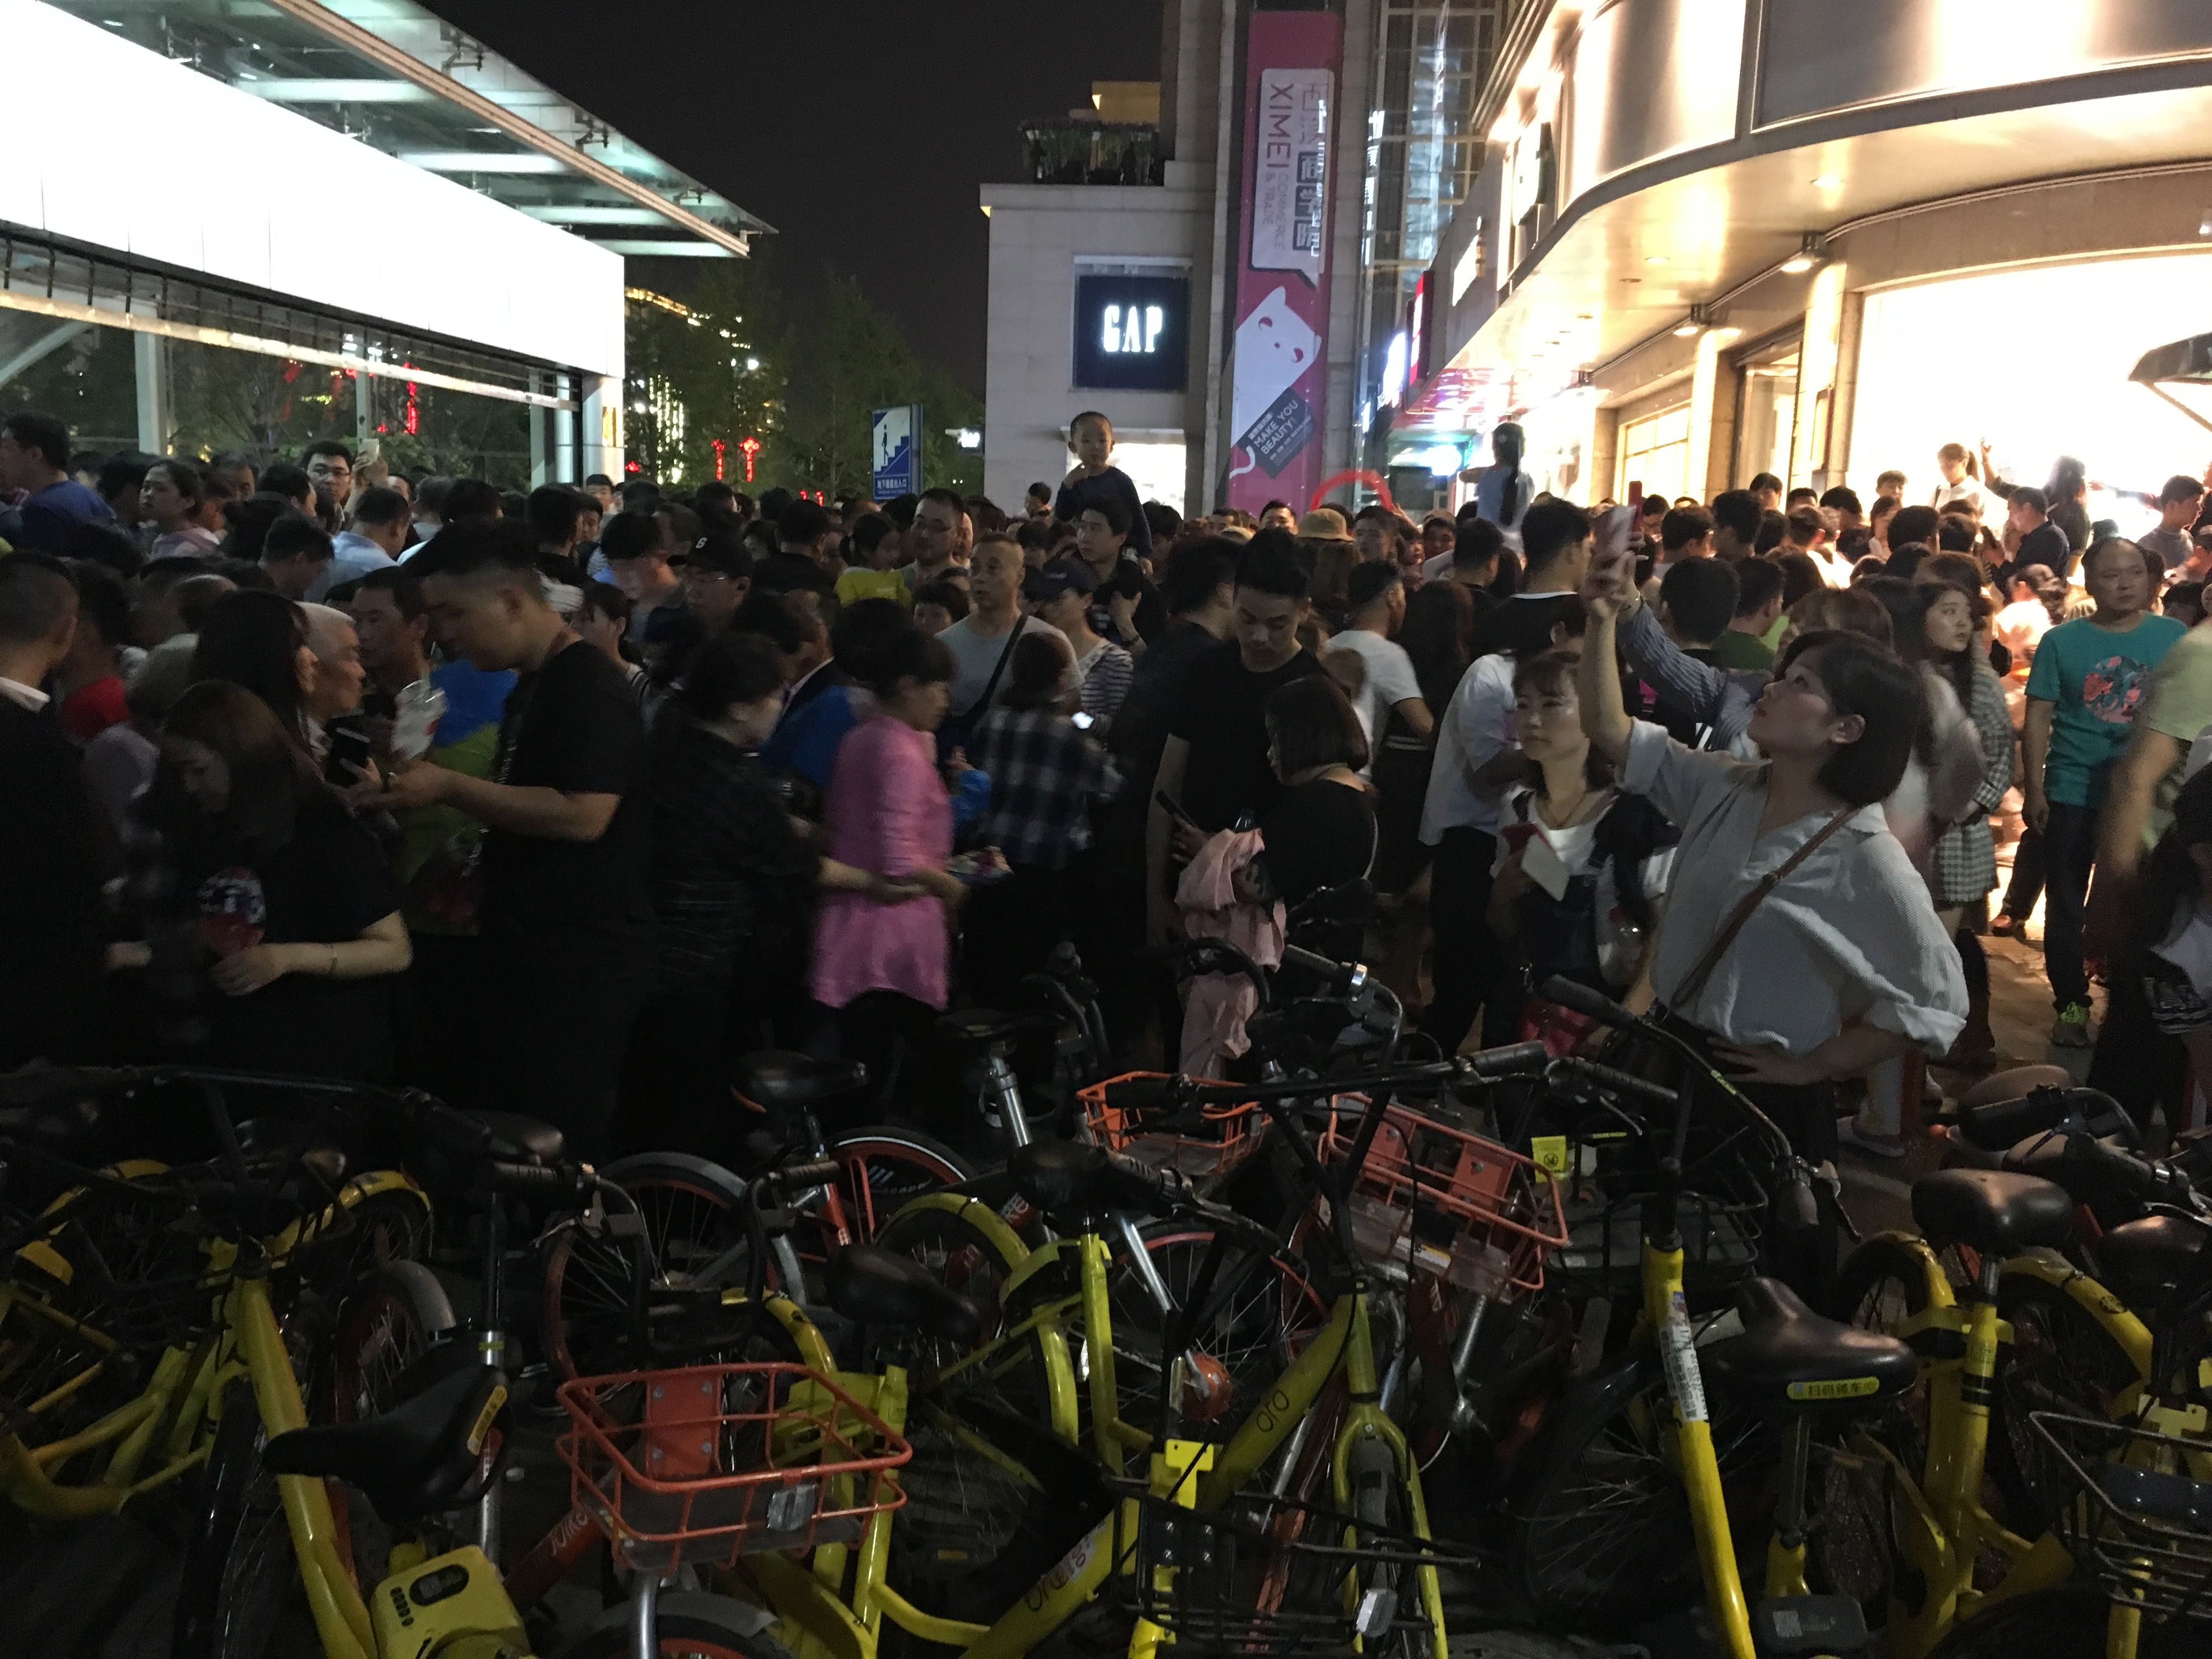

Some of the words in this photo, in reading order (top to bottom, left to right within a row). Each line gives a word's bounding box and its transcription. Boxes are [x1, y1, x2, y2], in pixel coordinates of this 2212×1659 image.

[1266, 83, 1294, 168] XIMEI
[1263, 186, 1276, 225] TRADE
[1274, 172, 1289, 250] COMMERCE
[1103, 305, 1163, 352] GAP
[1254, 421, 1279, 448] MAKE
[1277, 399, 1298, 421] YOU
